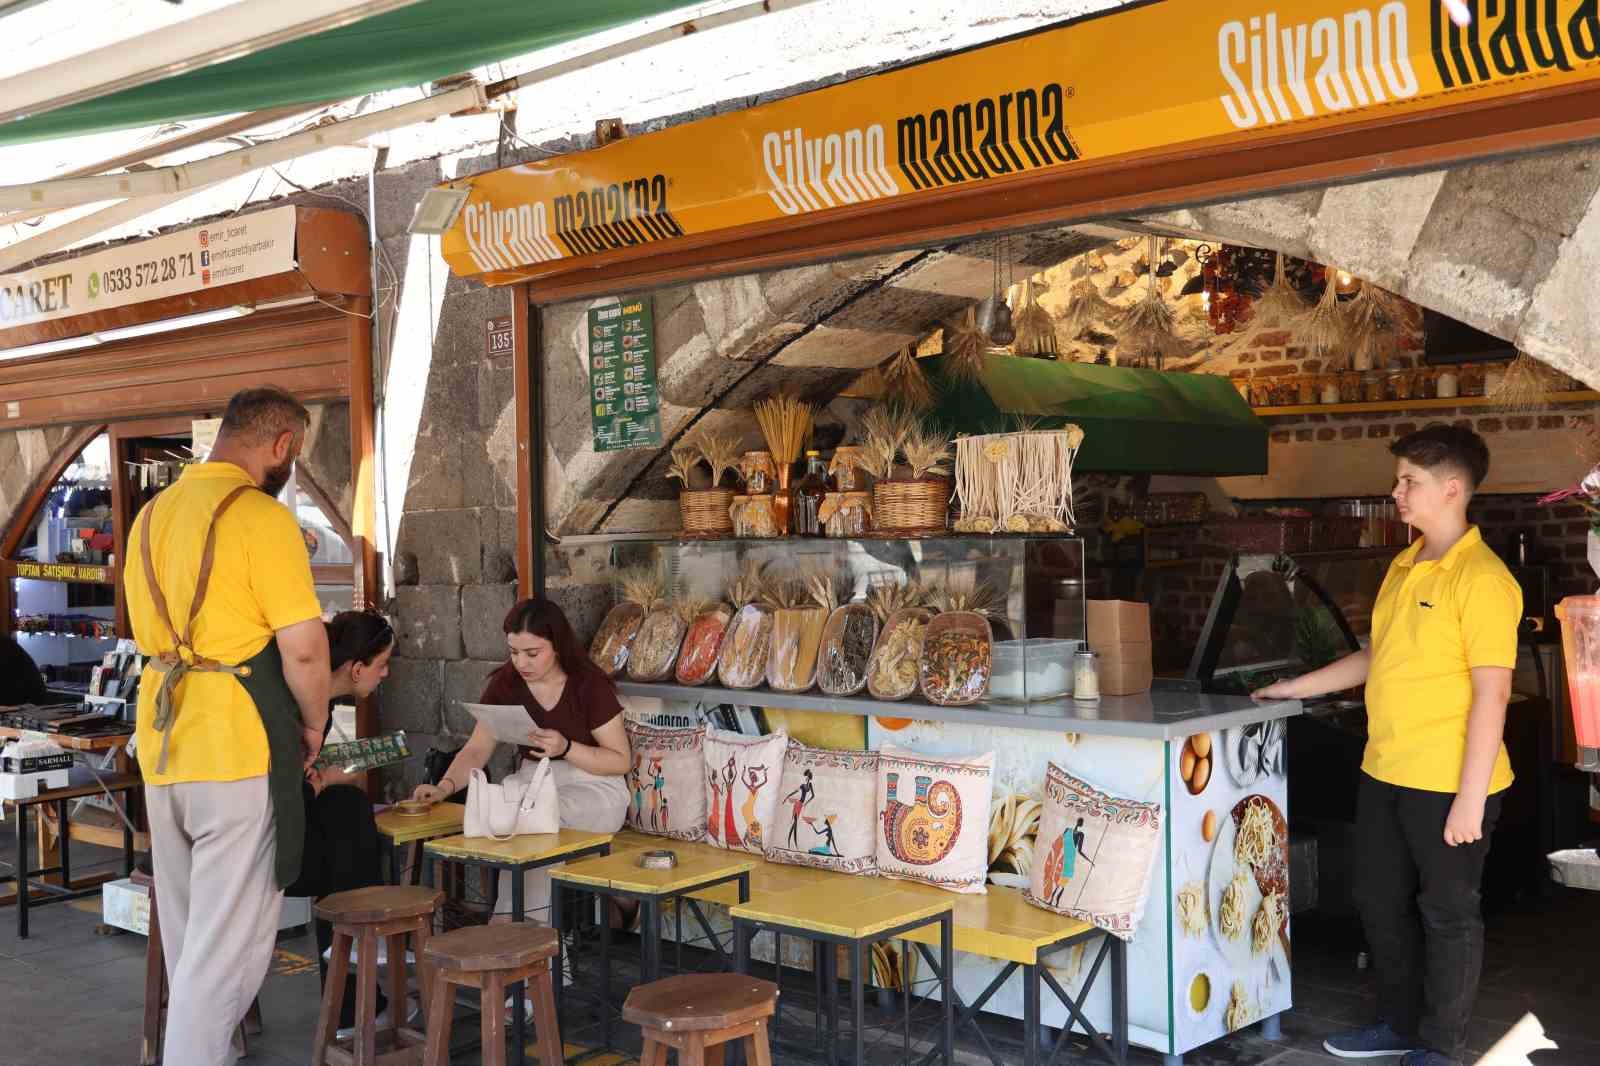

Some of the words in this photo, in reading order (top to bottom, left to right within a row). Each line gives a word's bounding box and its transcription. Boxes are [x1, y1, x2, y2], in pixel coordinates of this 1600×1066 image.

[1217, 1, 1419, 128] Silvano
[763, 124, 899, 215] Silvano
[897, 83, 1080, 190] maqarna
[103, 267, 132, 294] 0533
[135, 261, 158, 288] 572
[161, 255, 177, 281] 28
[179, 251, 195, 277] 71
[464, 201, 563, 272] Silvano
